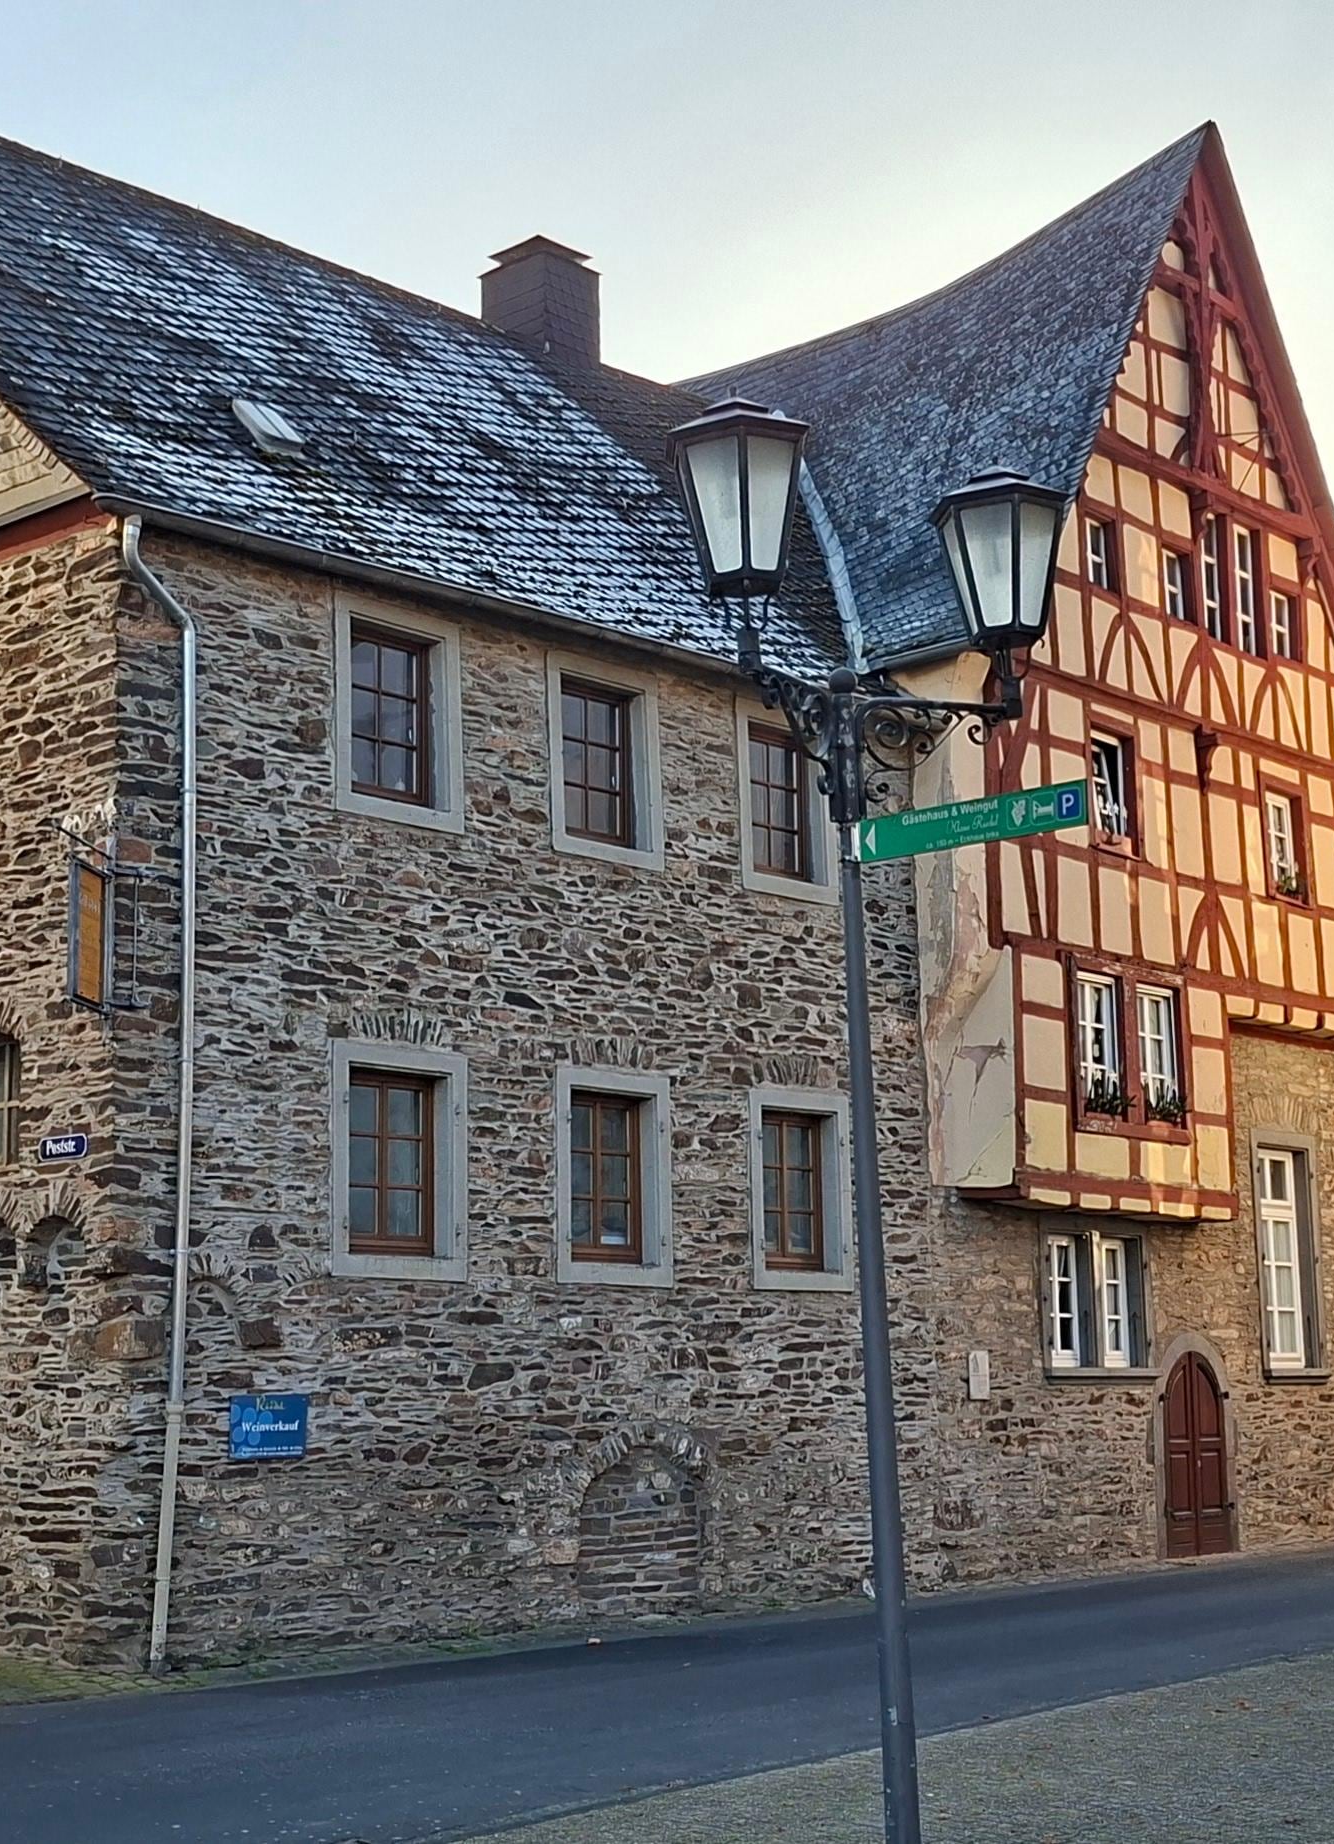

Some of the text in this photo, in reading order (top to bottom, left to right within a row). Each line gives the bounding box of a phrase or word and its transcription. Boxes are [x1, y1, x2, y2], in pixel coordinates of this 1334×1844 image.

[902, 799, 998, 825] Gästehaus & Weingut
[1062, 794, 1074, 815] P
[242, 1420, 299, 1432] Weinverkauf
